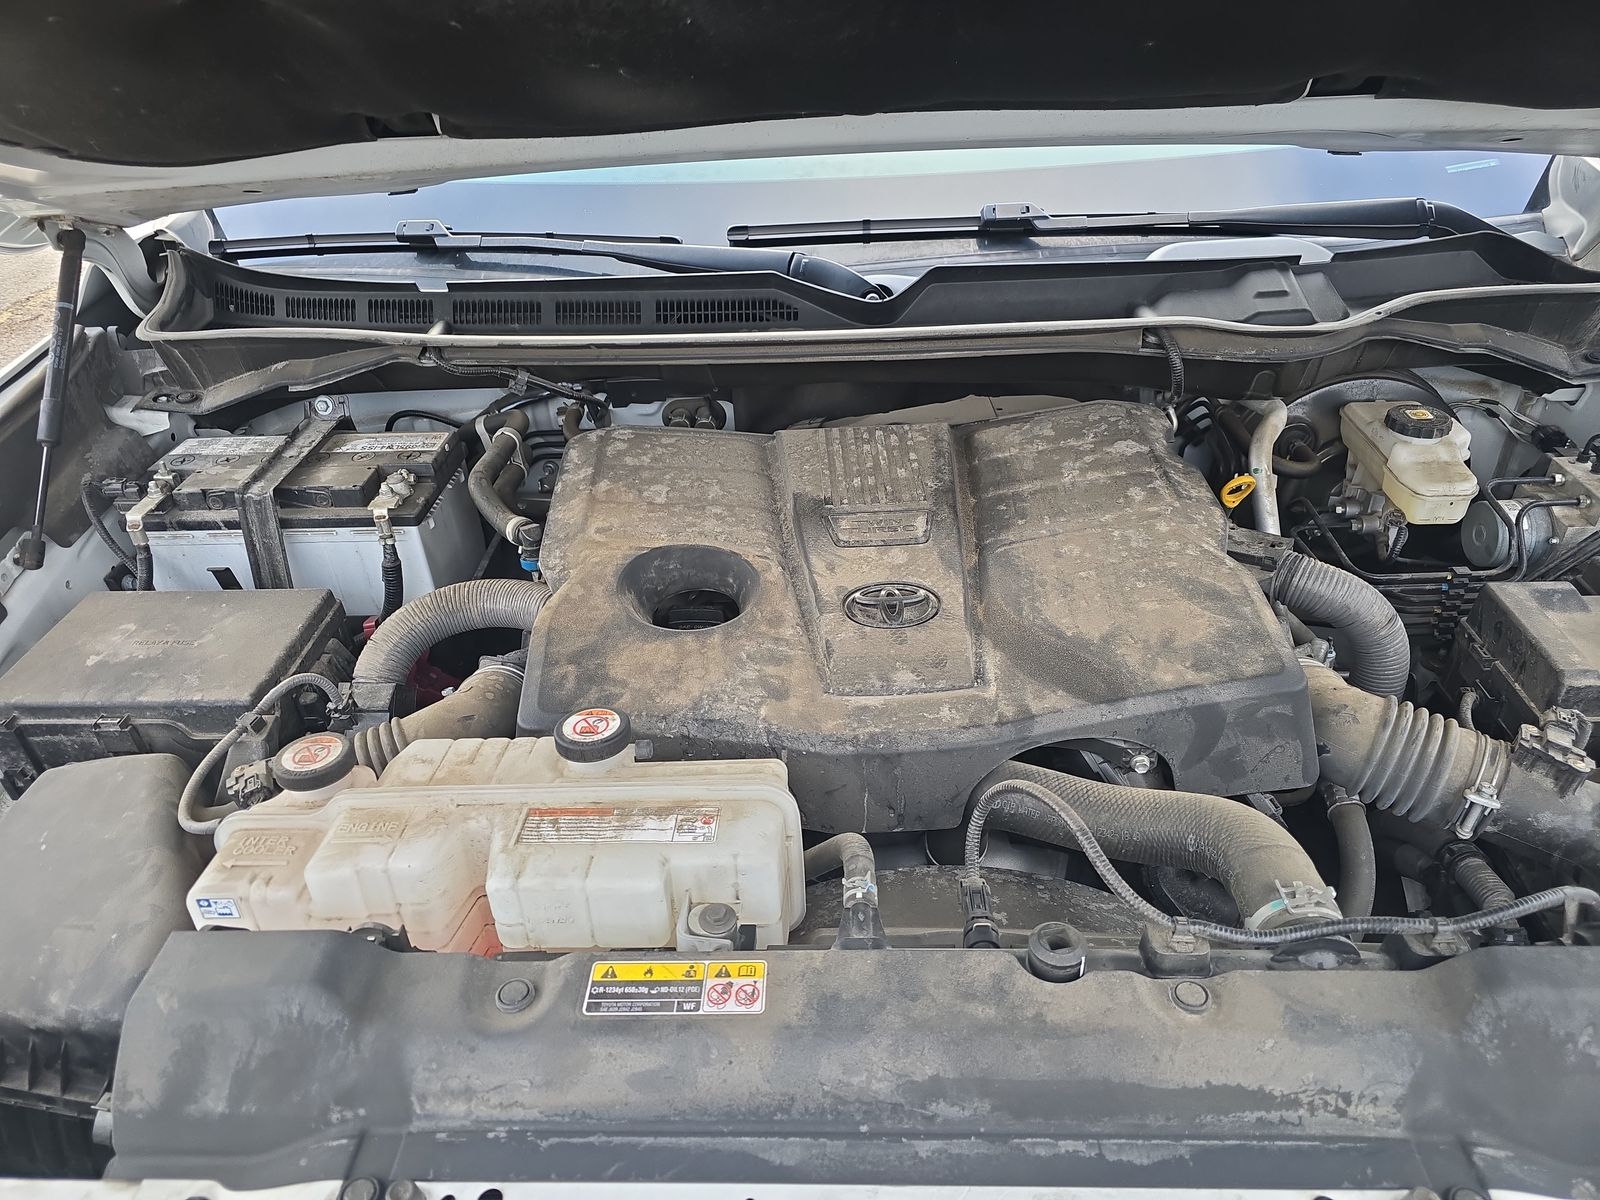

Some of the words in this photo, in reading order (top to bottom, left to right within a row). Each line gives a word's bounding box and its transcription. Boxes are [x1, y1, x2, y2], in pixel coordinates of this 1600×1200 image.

[337, 822, 399, 833] ENGINE
[239, 836, 290, 848] INTER
[232, 846, 298, 856] COOLER
[683, 1002, 697, 1010] WF
